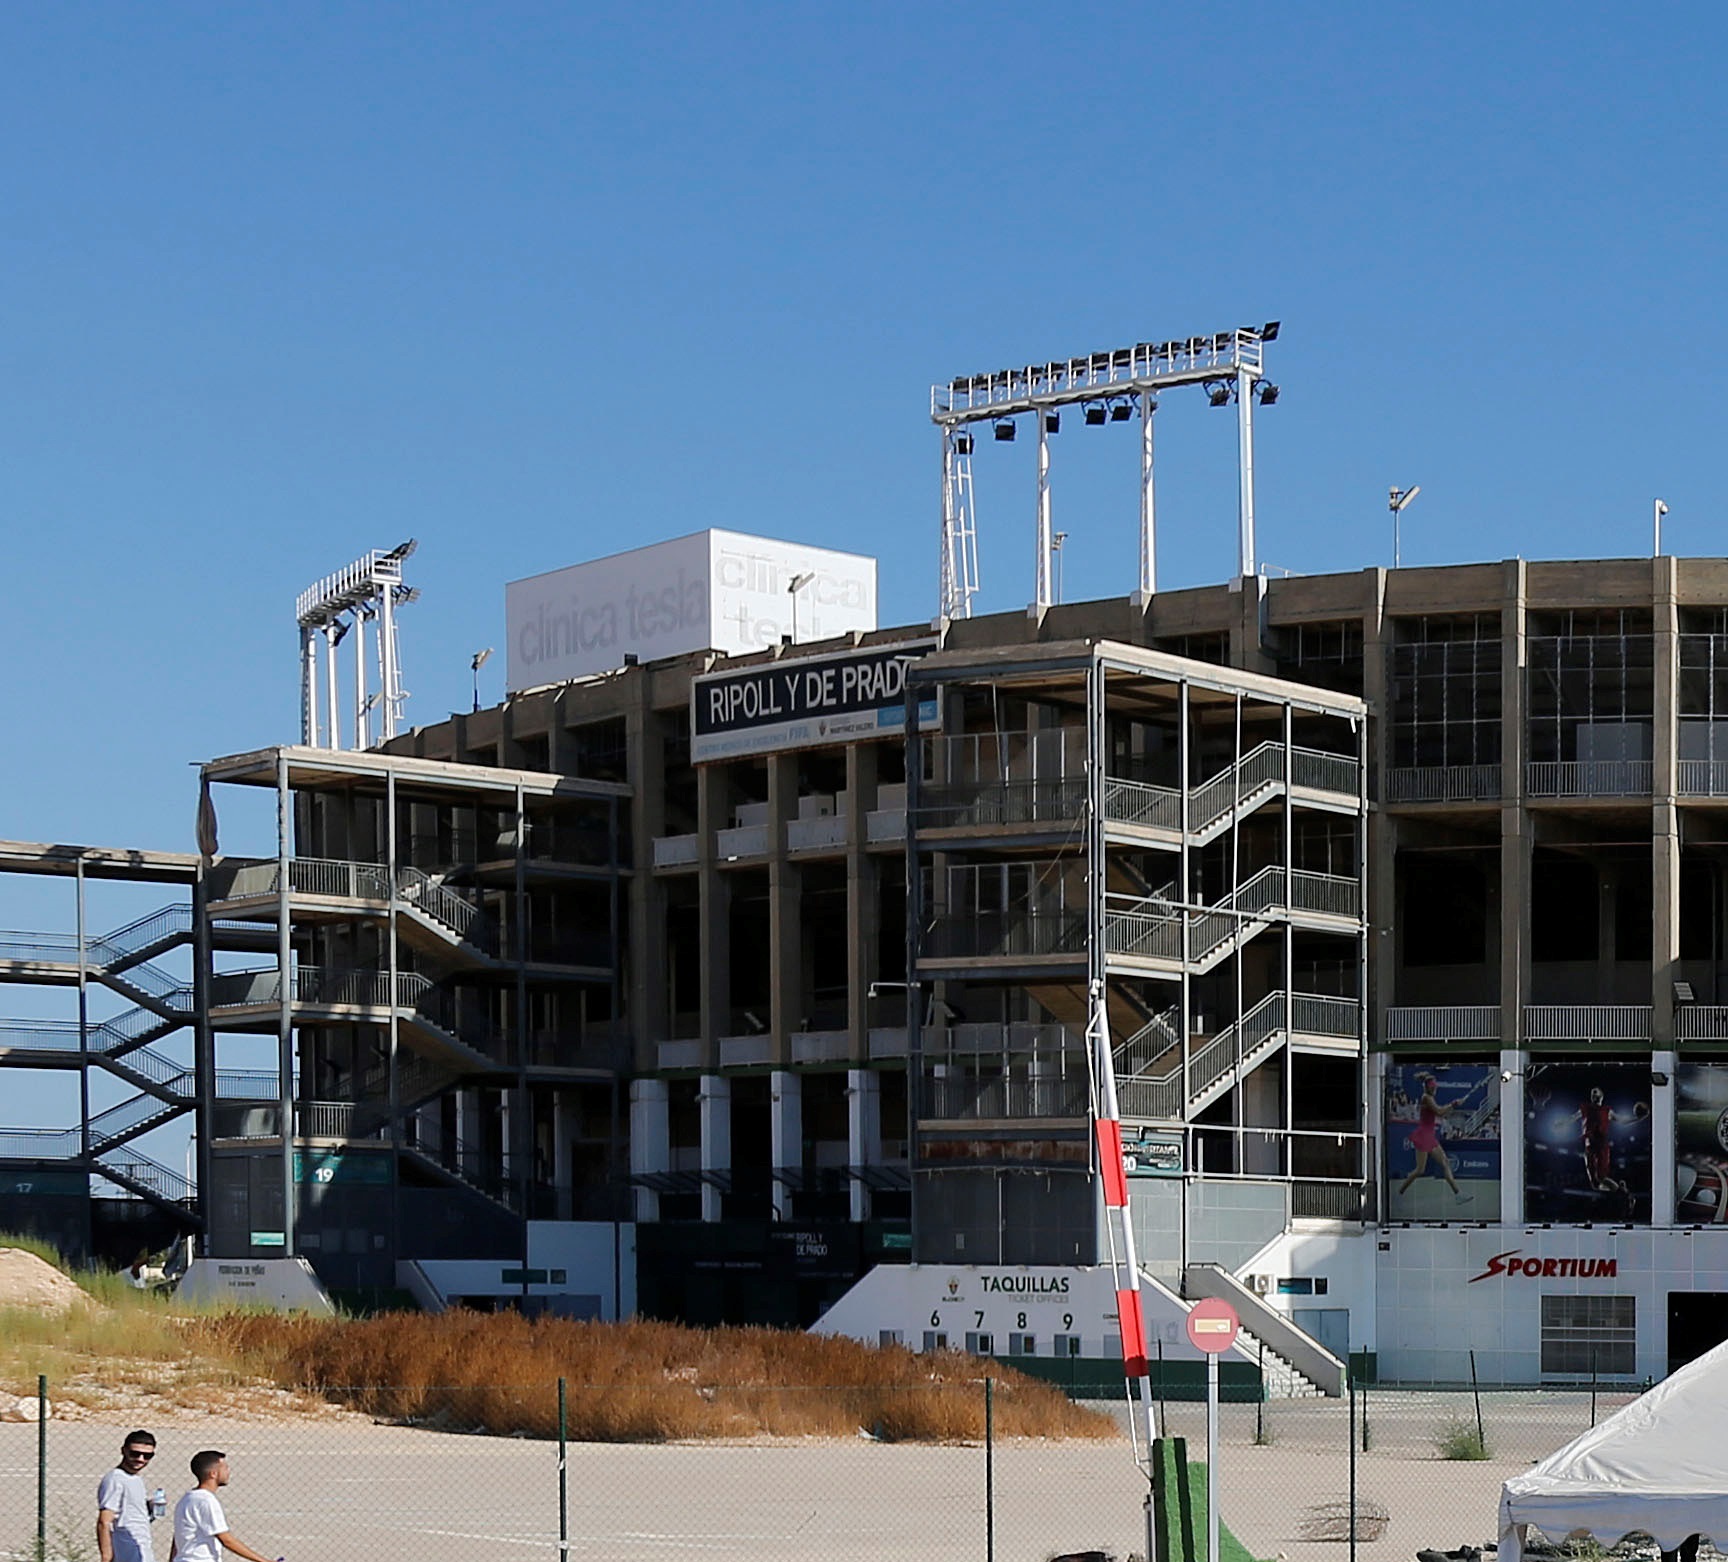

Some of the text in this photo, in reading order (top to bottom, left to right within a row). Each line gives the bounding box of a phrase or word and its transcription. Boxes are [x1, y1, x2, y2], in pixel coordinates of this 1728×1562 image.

[626, 568, 706, 640] tesla
[710, 678, 782, 724] RIPOLL
[785, 673, 800, 711] Y
[806, 669, 837, 709] DE
[315, 1168, 334, 1183] 19
[16, 1183, 33, 1193] 17
[1468, 1249, 1617, 1284] SPORTIUM
[981, 1276, 1070, 1294] TAQUILLAS
[1008, 1294, 1069, 1304] TICKET OFFICES
[930, 1310, 1073, 1331] 6 7 8 9
